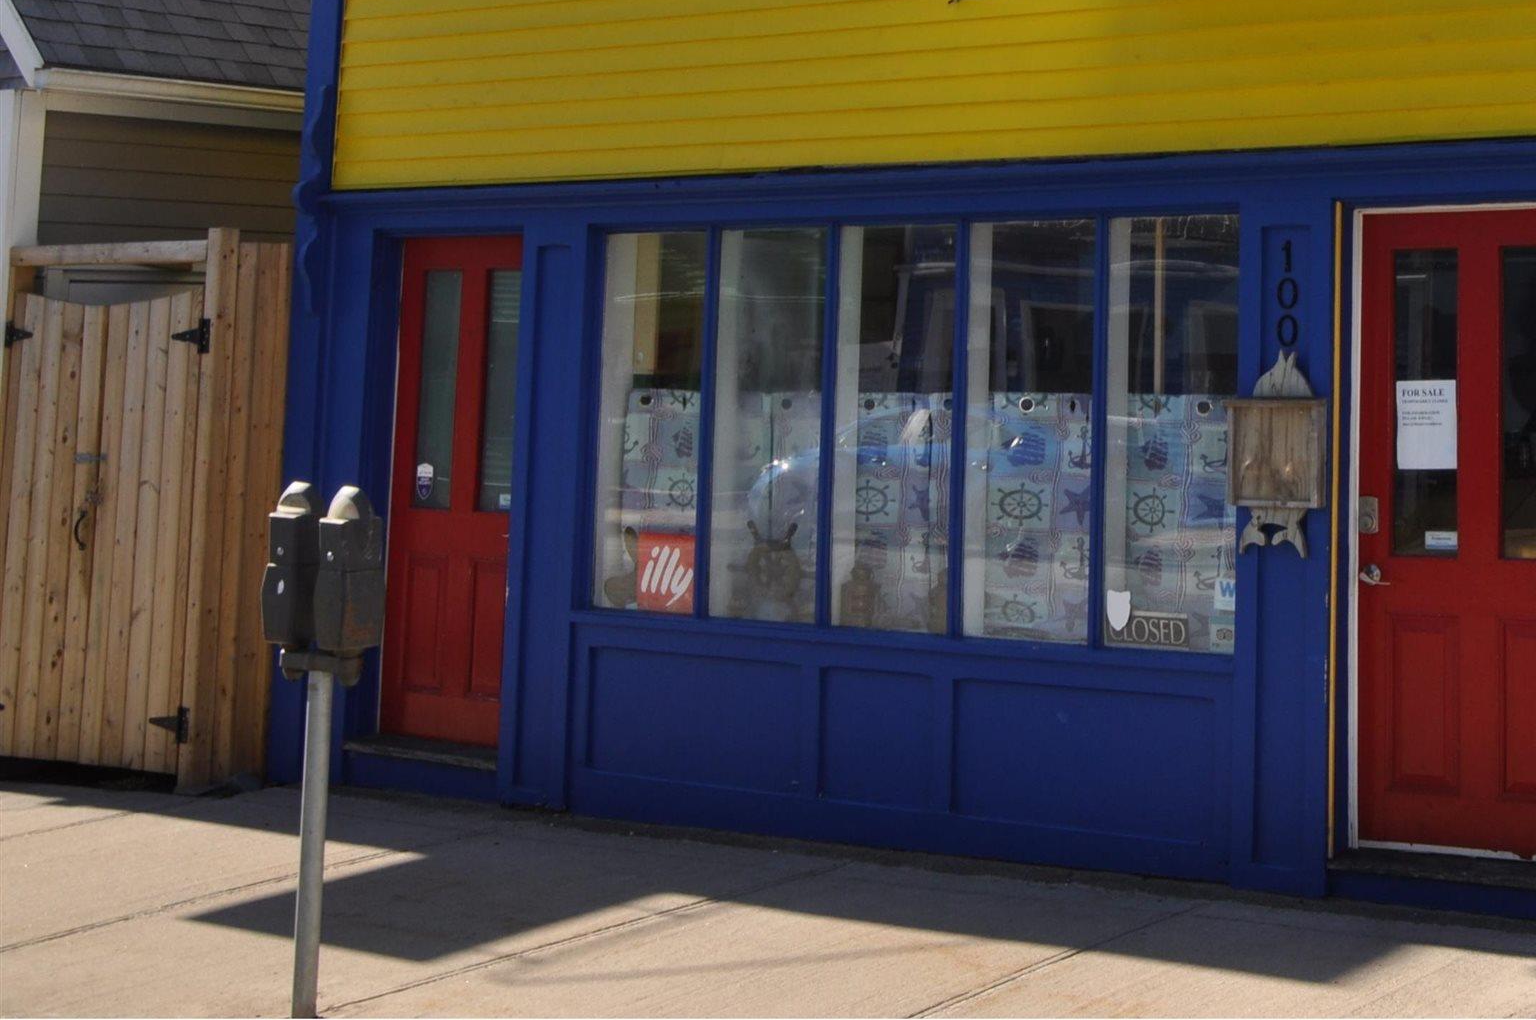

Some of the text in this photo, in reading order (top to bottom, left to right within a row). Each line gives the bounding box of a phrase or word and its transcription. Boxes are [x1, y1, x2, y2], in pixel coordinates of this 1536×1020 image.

[1276, 239, 1299, 348] 100
[1402, 388, 1445, 397] FOR SALE
[641, 546, 694, 607] illy
